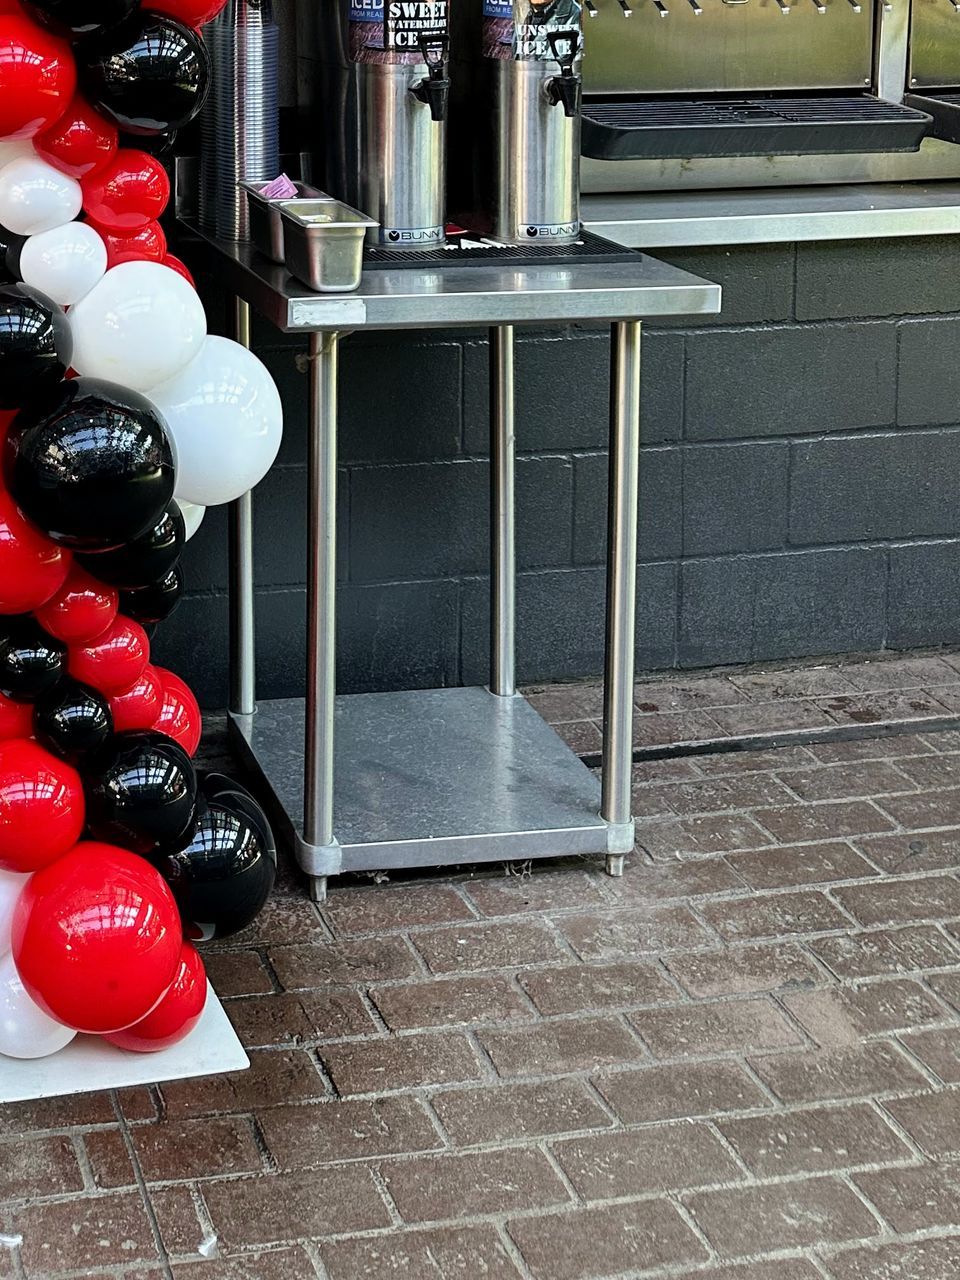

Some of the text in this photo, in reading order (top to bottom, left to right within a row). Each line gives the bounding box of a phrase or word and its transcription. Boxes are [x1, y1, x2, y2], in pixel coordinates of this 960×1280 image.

[351, 10, 366, 18] FROM
[389, 1, 447, 18] SWEET
[387, 19, 447, 29] WATERMELON
[388, 31, 419, 46] ICE
[515, 40, 547, 55] ICE
[401, 230, 440, 240] BUNN
[539, 223, 575, 237] BUNN
